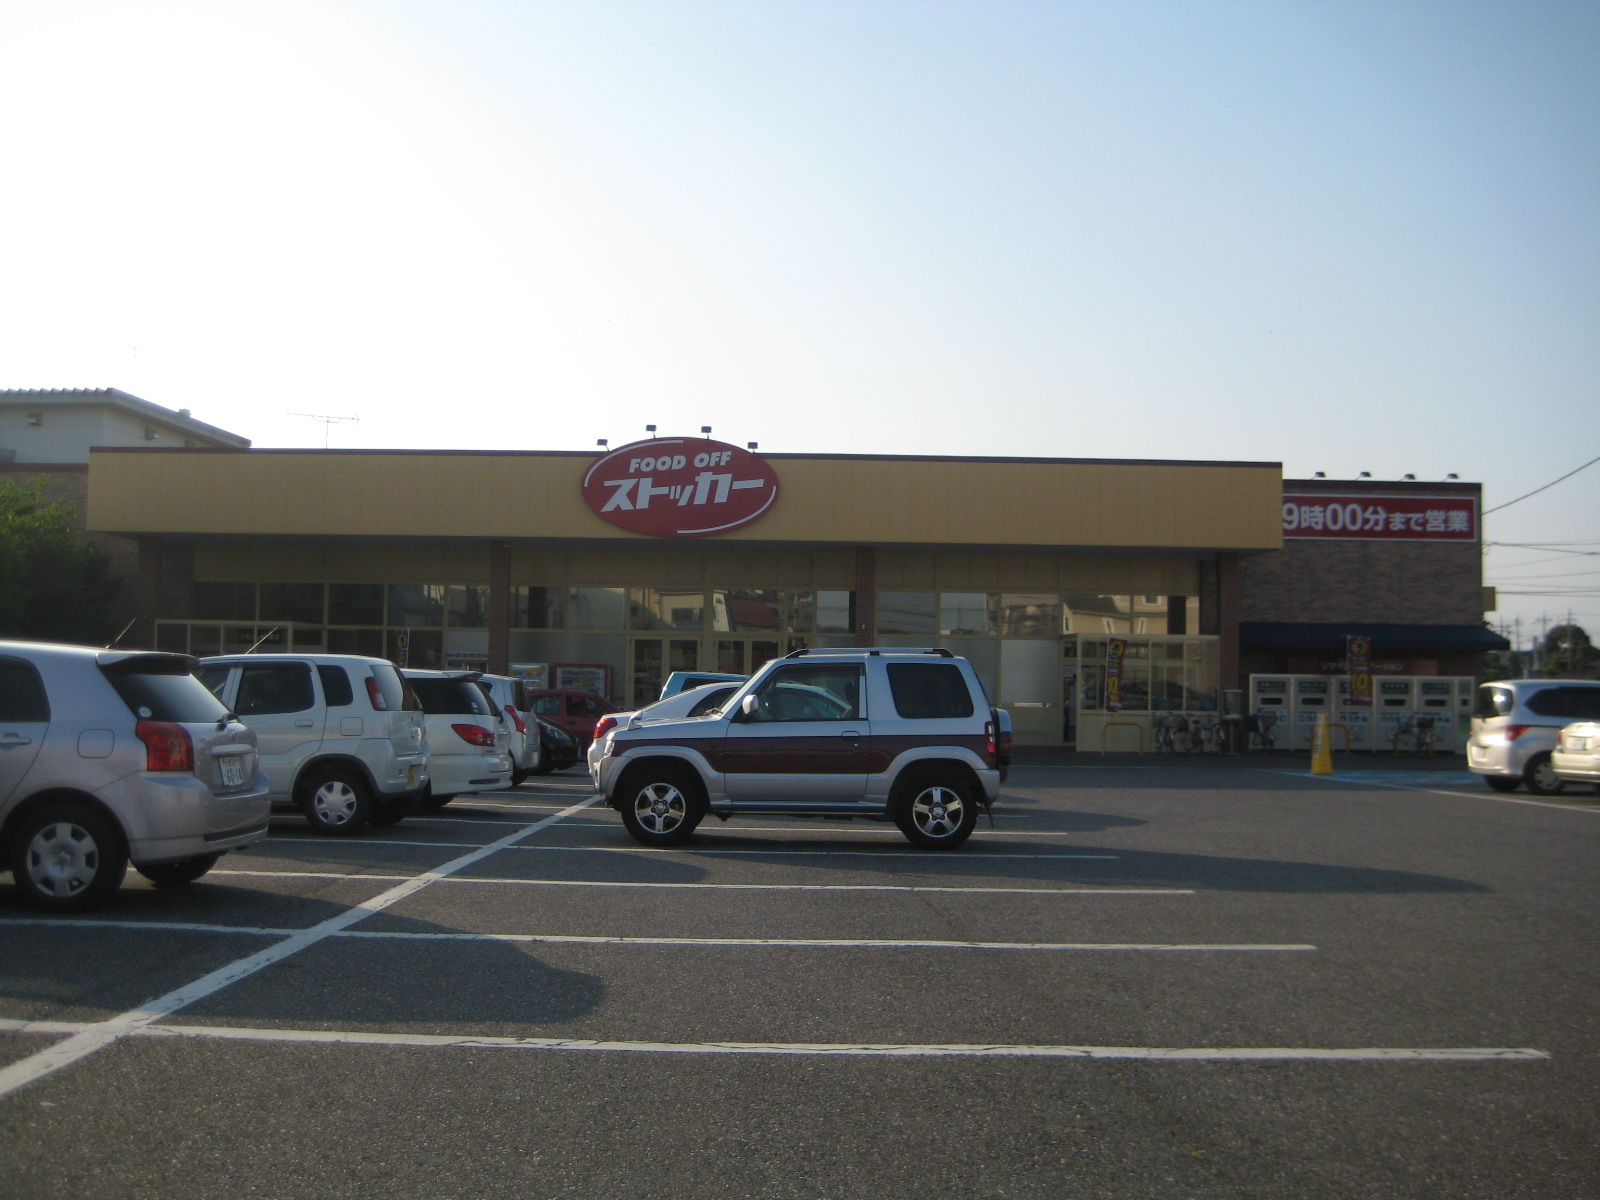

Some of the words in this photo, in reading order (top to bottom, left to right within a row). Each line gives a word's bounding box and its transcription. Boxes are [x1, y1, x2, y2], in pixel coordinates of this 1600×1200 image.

[628, 455, 687, 473] FOOD
[693, 451, 733, 468] OFF
[600, 471, 765, 513] ストッカー
